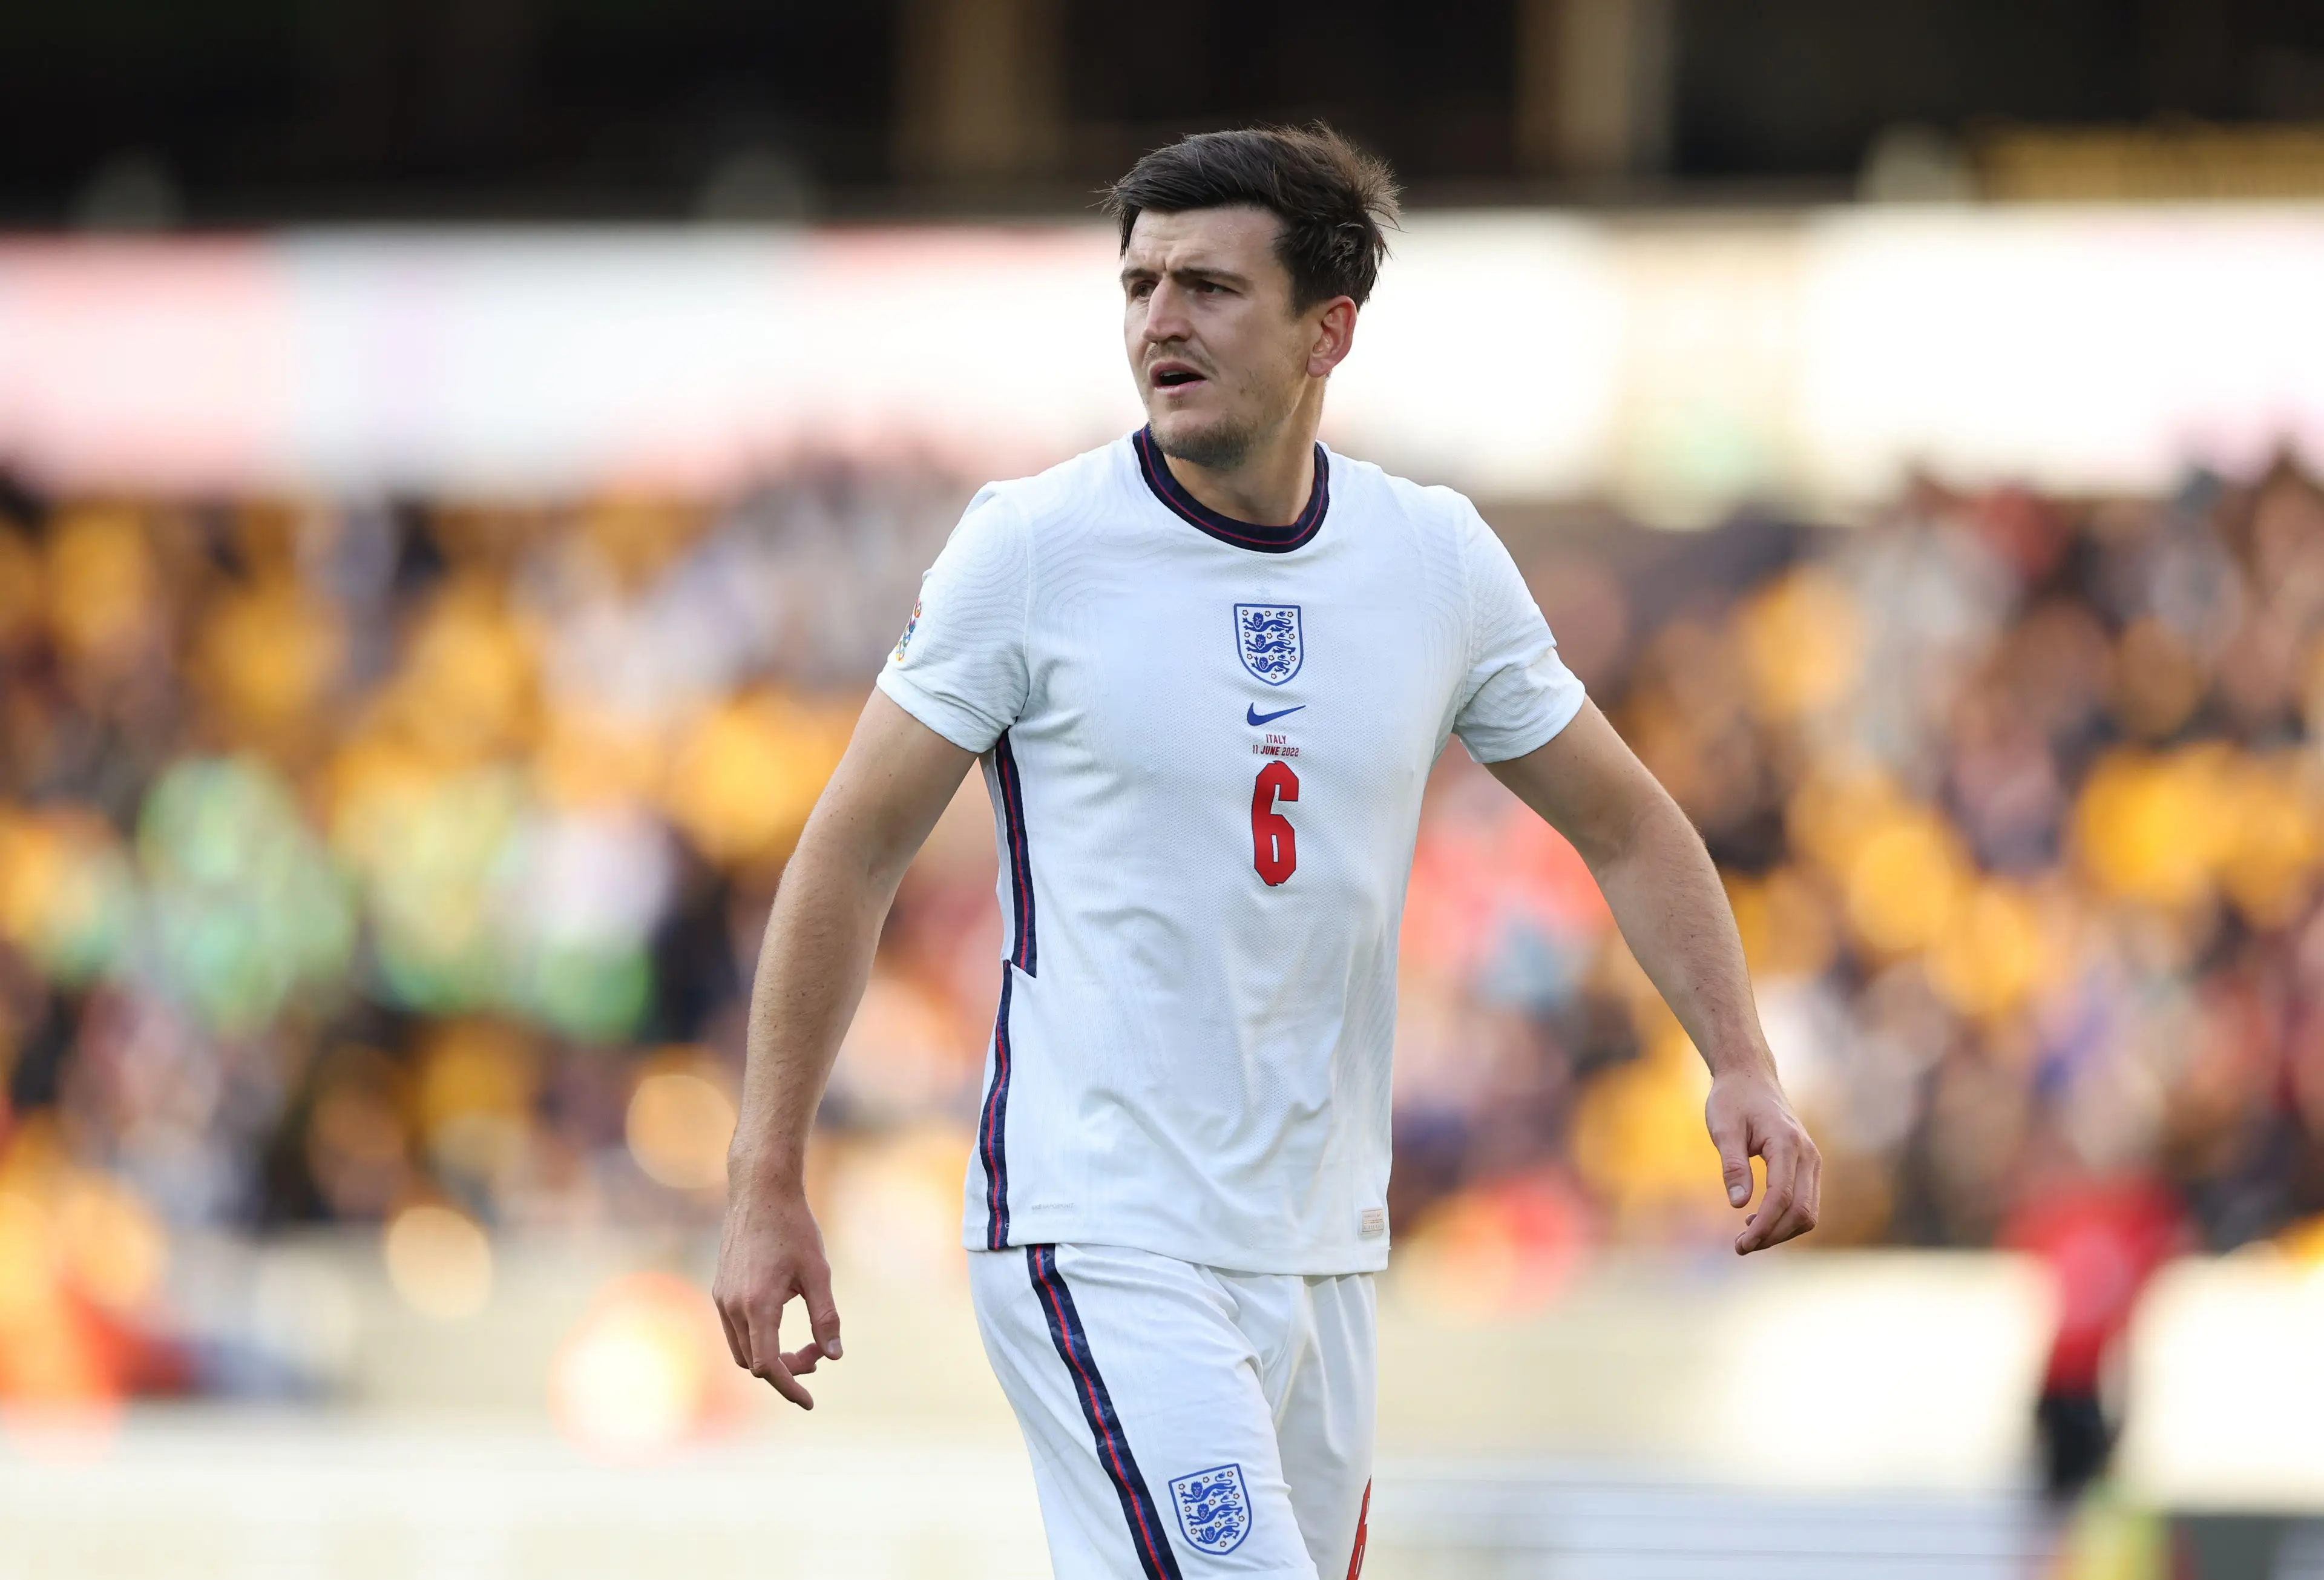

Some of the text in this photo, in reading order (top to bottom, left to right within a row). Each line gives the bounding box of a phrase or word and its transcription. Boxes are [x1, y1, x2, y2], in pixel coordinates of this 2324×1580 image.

[1266, 734, 1286, 744] ITALY
[1253, 745, 1299, 757] 11 JUNE 2022
[1251, 760, 1299, 886] 6
